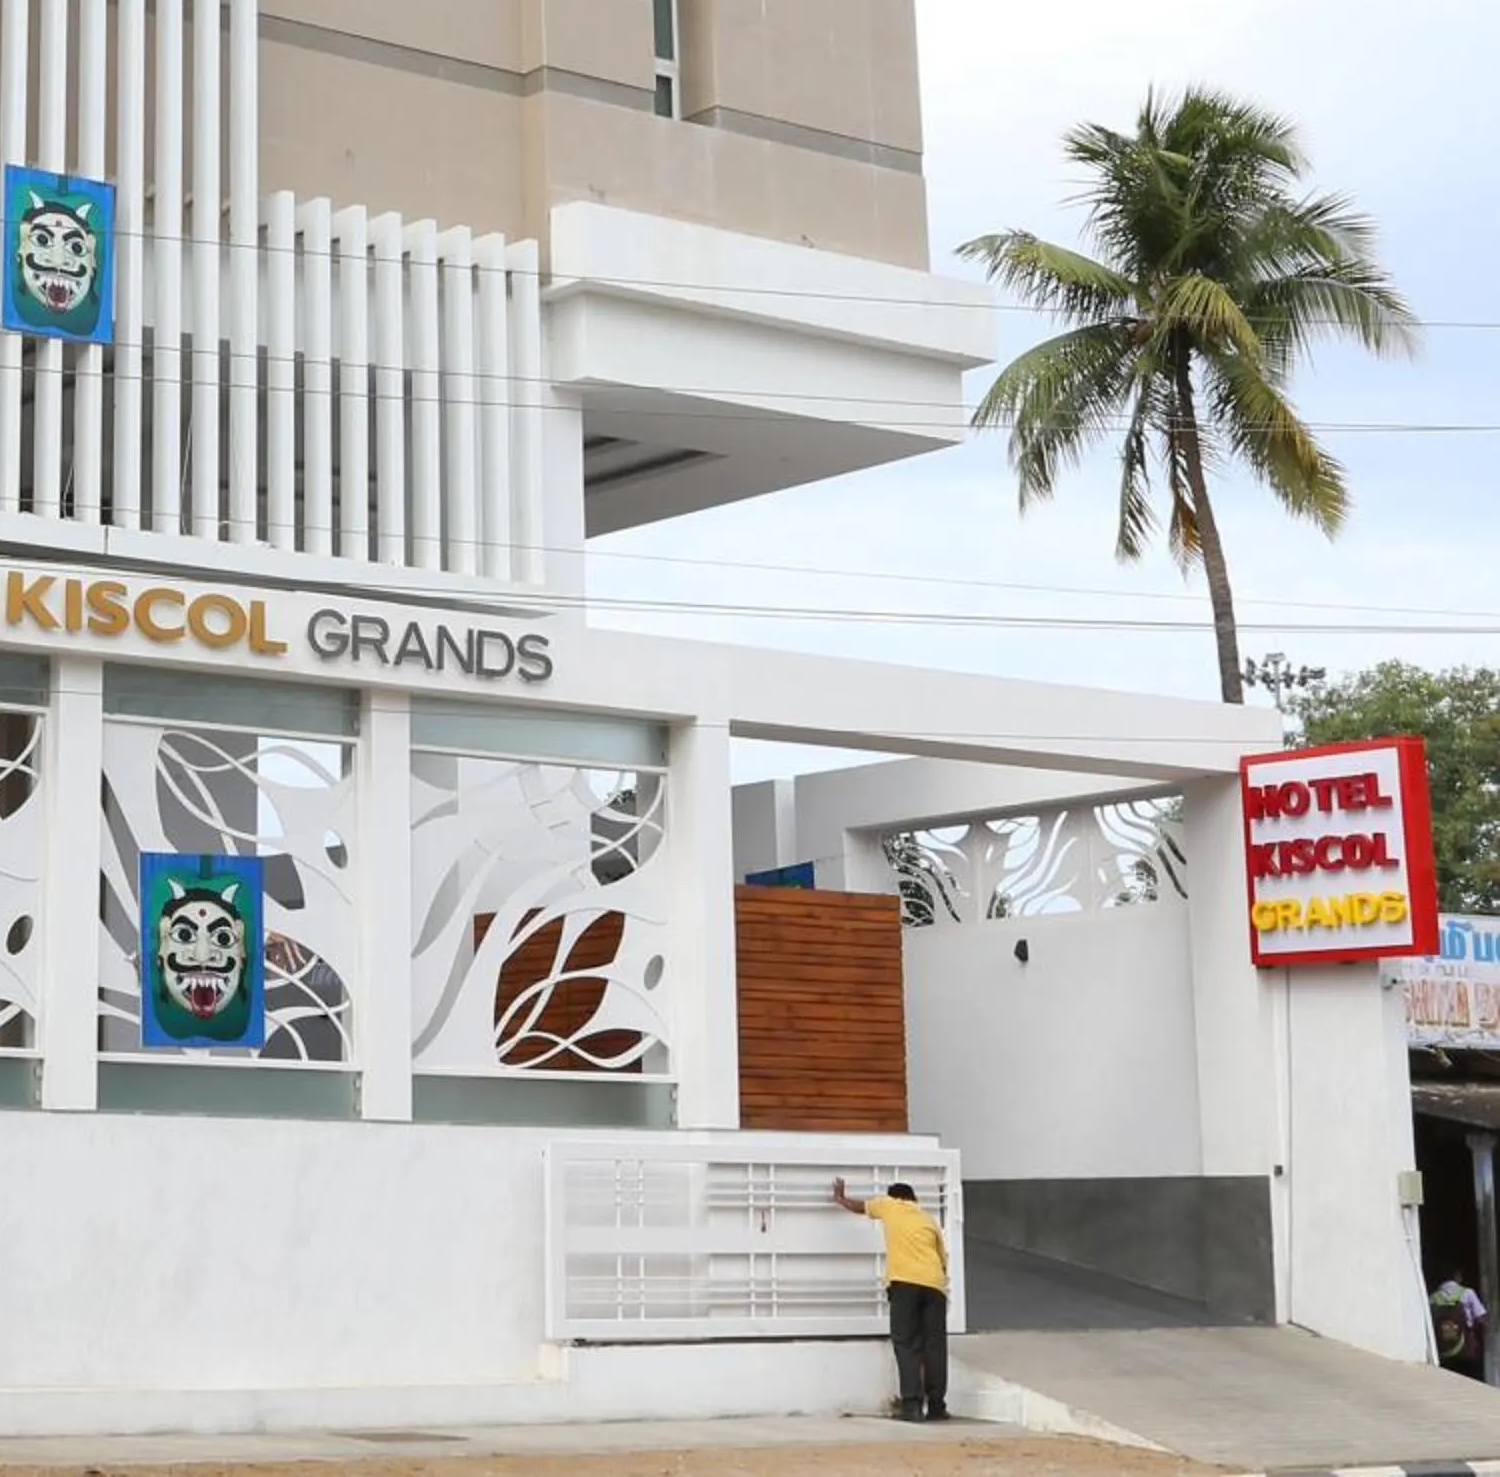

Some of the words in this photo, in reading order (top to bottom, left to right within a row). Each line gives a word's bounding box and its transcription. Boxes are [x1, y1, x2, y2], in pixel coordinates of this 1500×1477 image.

[6, 570, 287, 655] KISCOL
[307, 608, 554, 685] GRANDS
[1249, 772, 1394, 821] HOTEL
[1252, 832, 1400, 879] KISCOL
[1251, 890, 1408, 933] GRANDS
